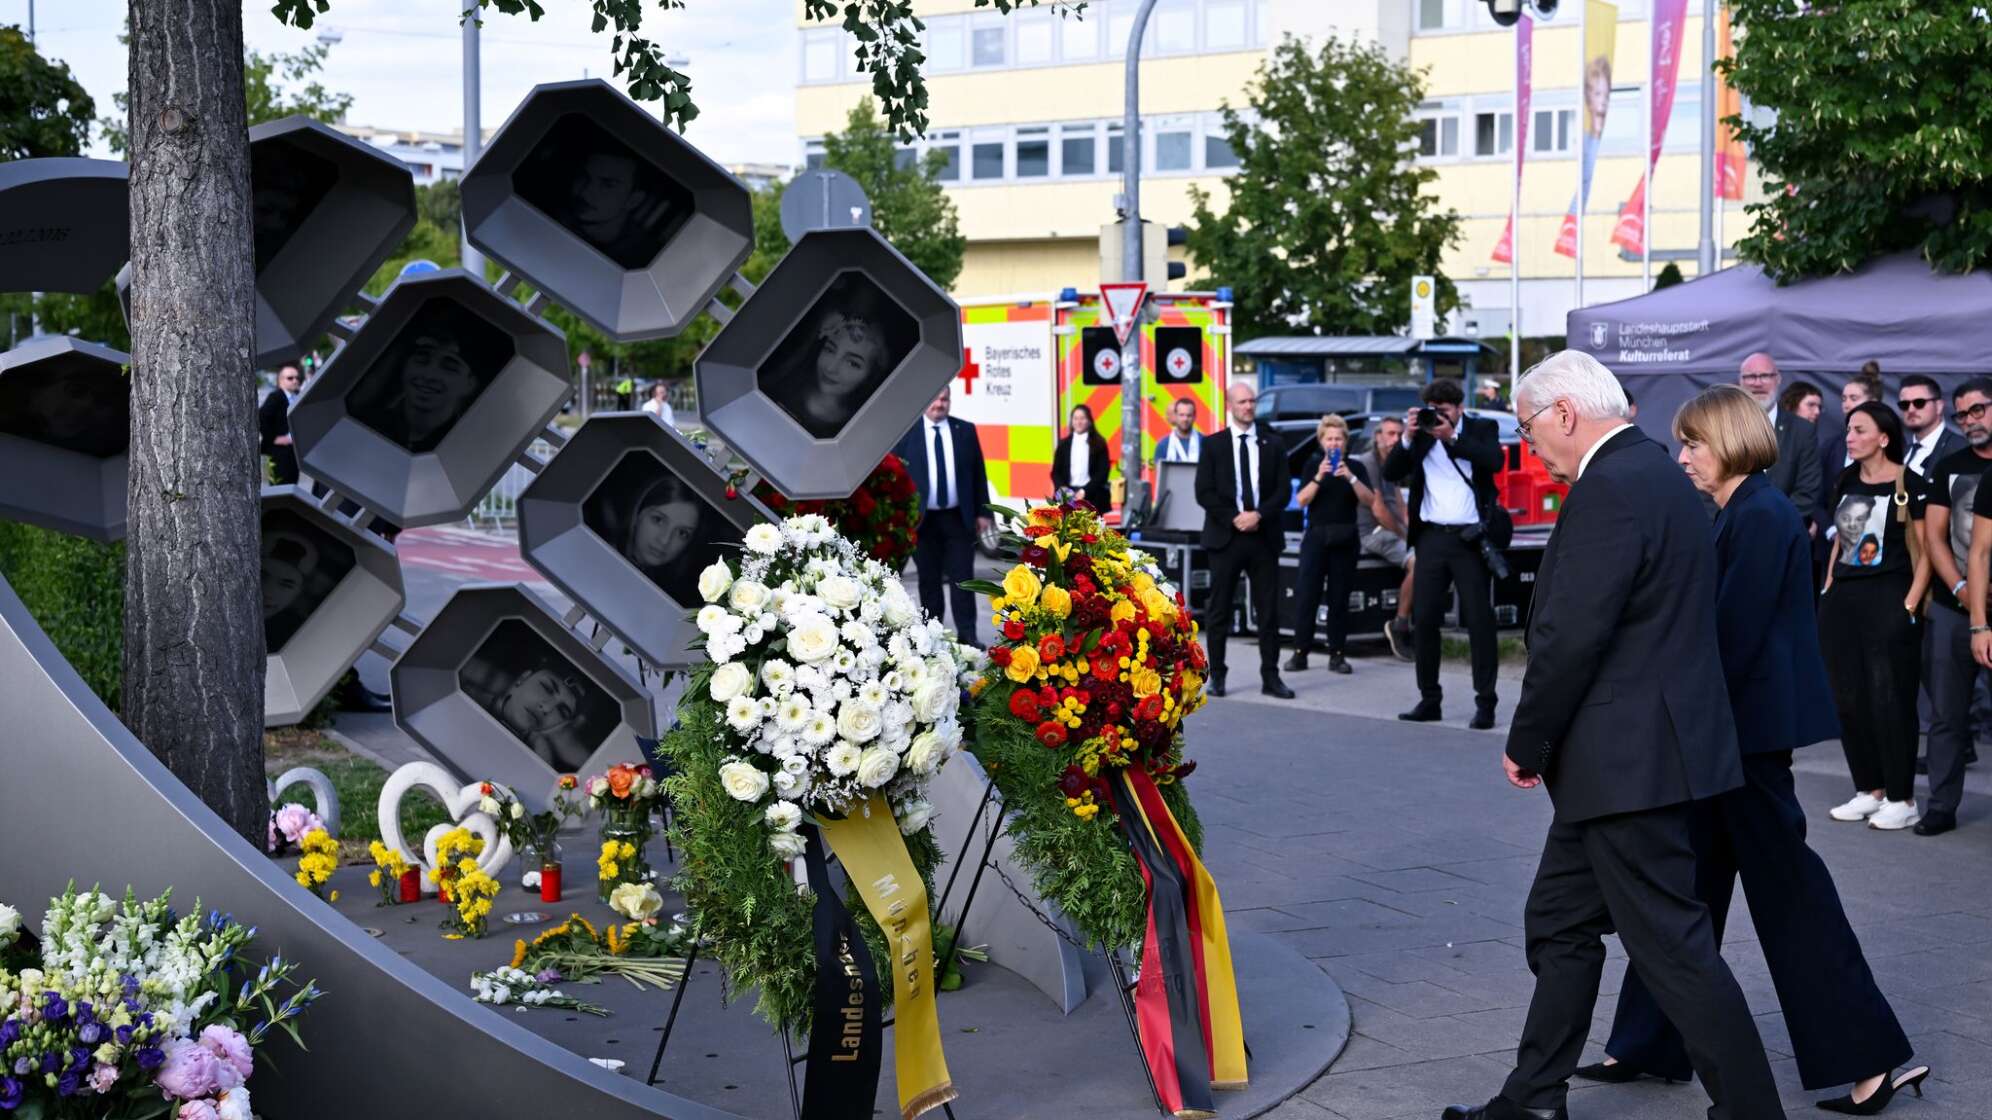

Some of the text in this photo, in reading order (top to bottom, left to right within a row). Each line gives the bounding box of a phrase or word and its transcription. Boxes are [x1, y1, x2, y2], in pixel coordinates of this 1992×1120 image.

[1619, 320, 1709, 336] Landeshauptstadt
[1619, 336, 1668, 348] München
[985, 346, 1041, 364] Bayerisches
[1619, 348, 1691, 362] Kulturreferat
[985, 364, 1012, 378] Rotes
[985, 384, 1012, 397] Kreuz
